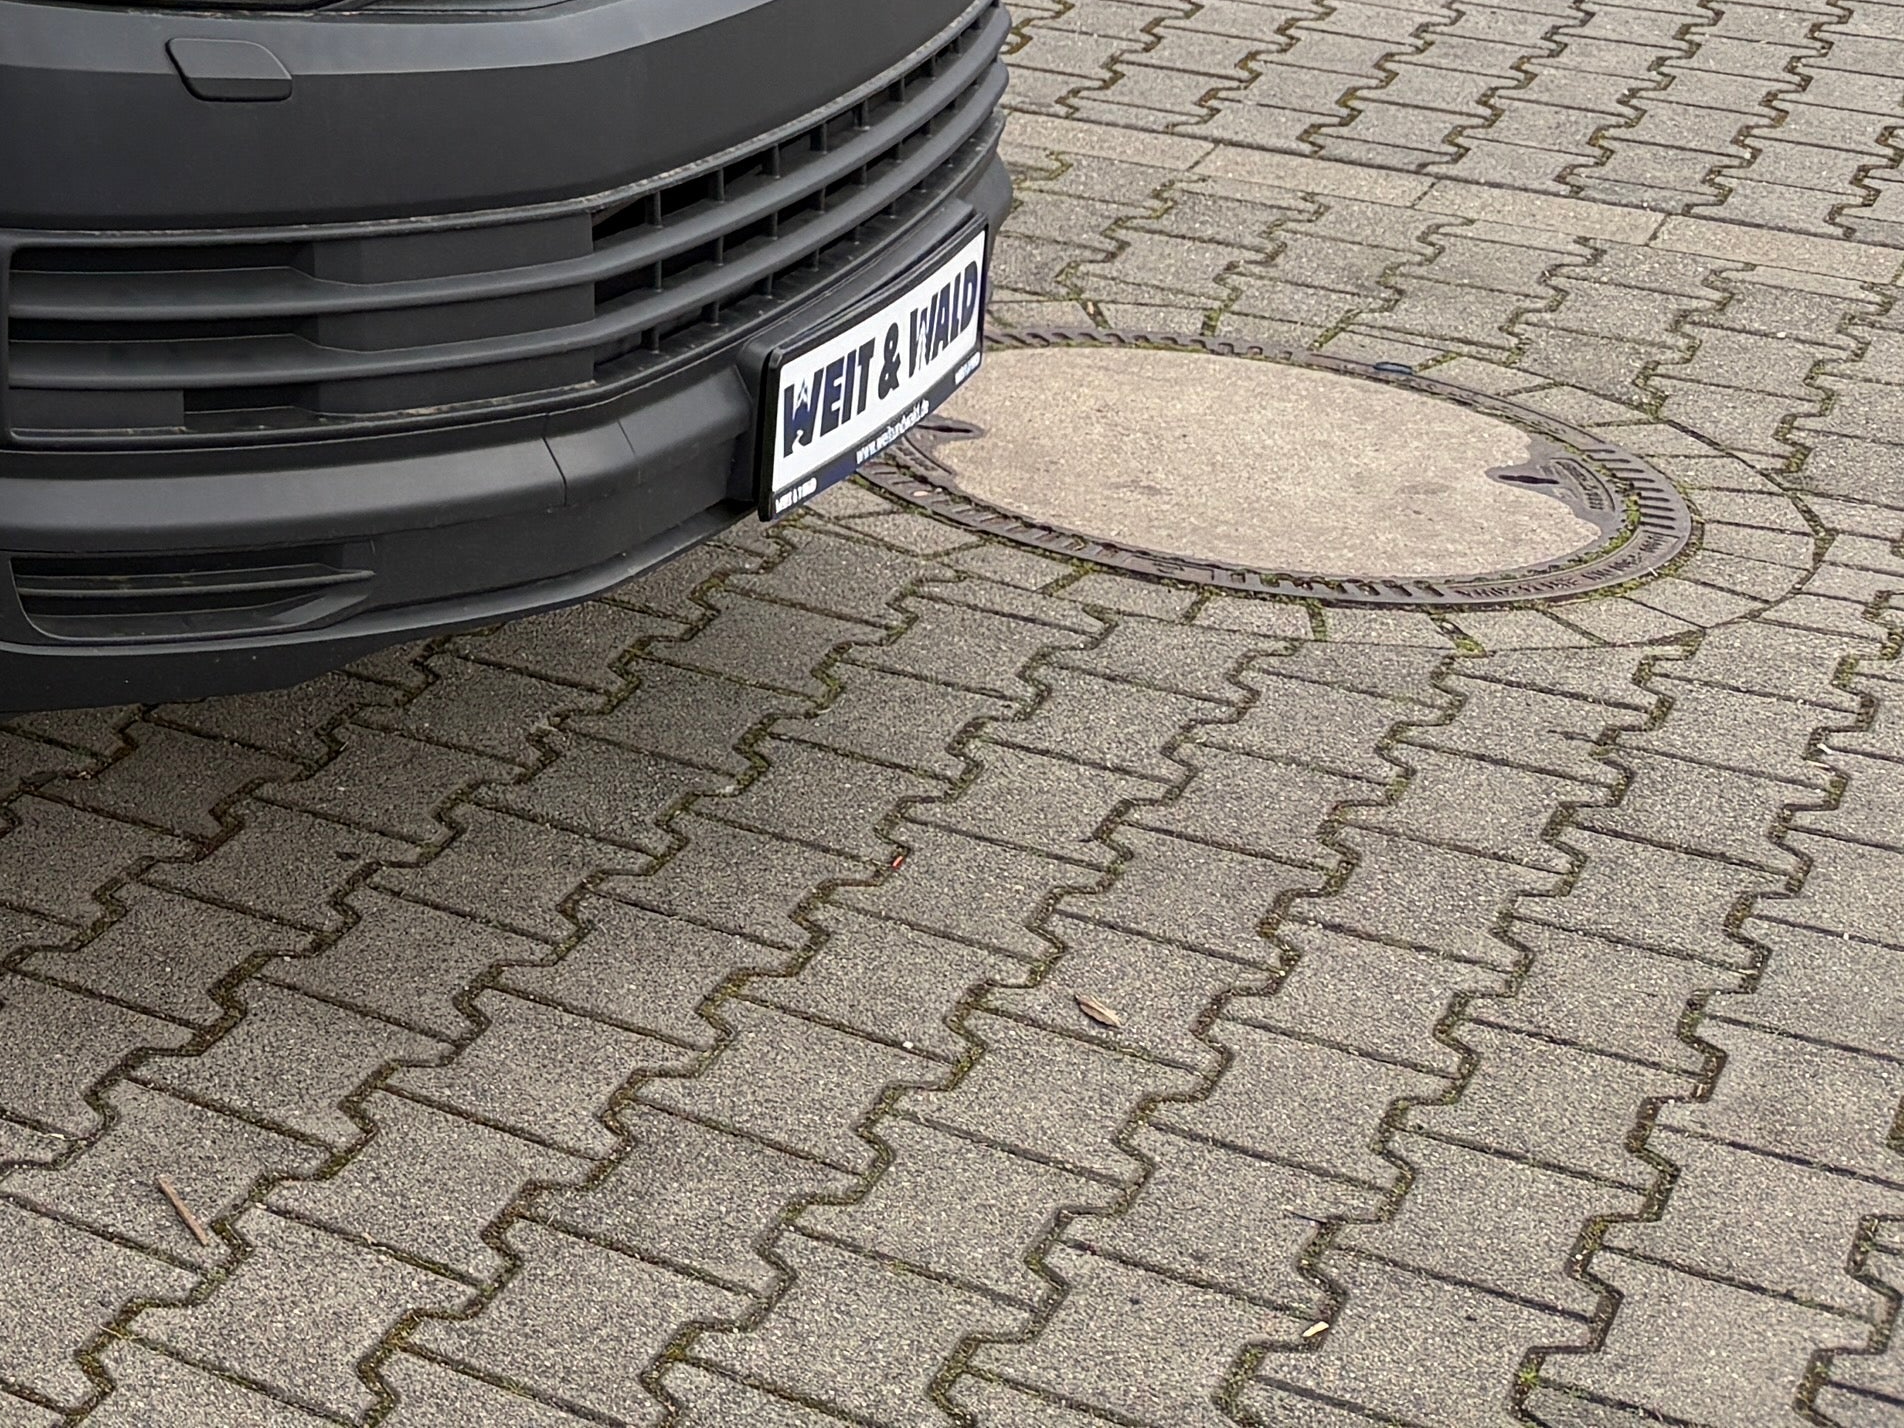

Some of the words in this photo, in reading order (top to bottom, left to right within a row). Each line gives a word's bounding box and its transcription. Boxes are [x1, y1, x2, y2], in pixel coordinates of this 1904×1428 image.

[783, 337, 875, 459] WEIT
[878, 321, 900, 401] &
[908, 259, 978, 379] WALD
